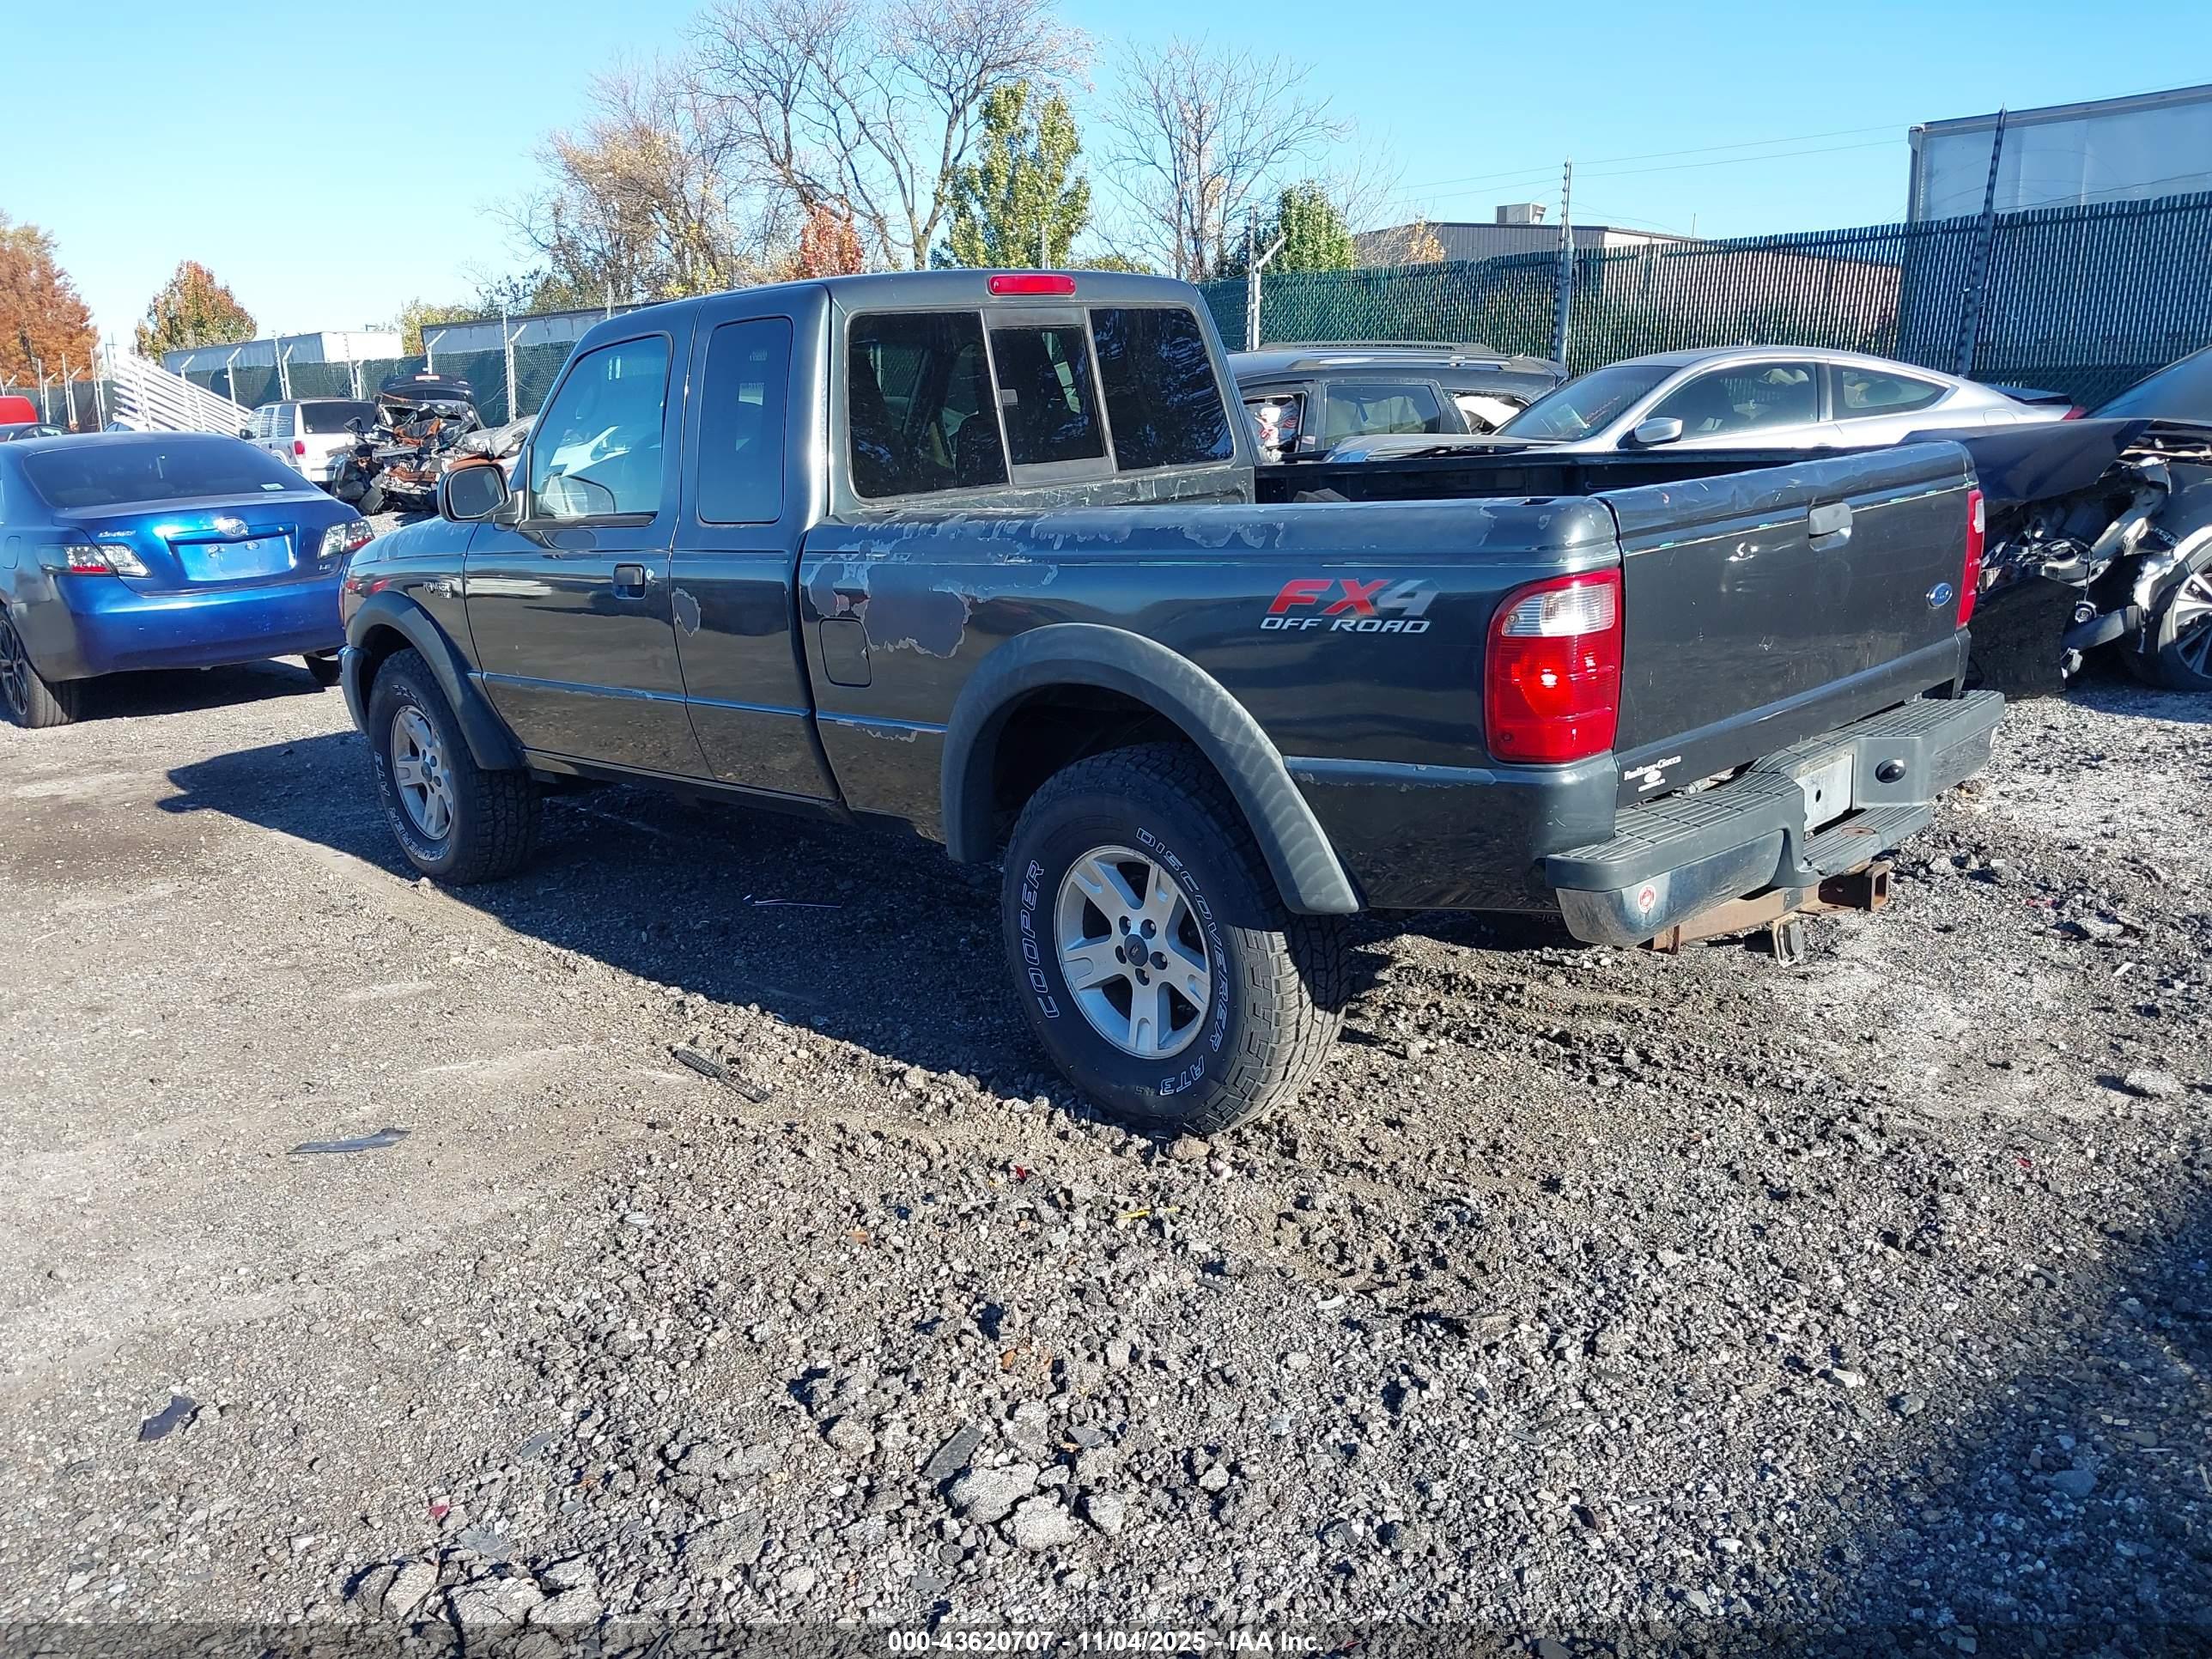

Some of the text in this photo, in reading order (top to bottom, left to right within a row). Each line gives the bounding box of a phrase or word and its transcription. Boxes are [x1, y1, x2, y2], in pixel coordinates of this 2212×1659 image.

[1267, 577, 1442, 617] FX4
[1260, 617, 1431, 634] OFF ROAD
[1019, 859, 1060, 1019] COOPER
[1135, 826, 1230, 1053] DISCOVERER
[1159, 1054, 1206, 1097] AT3
